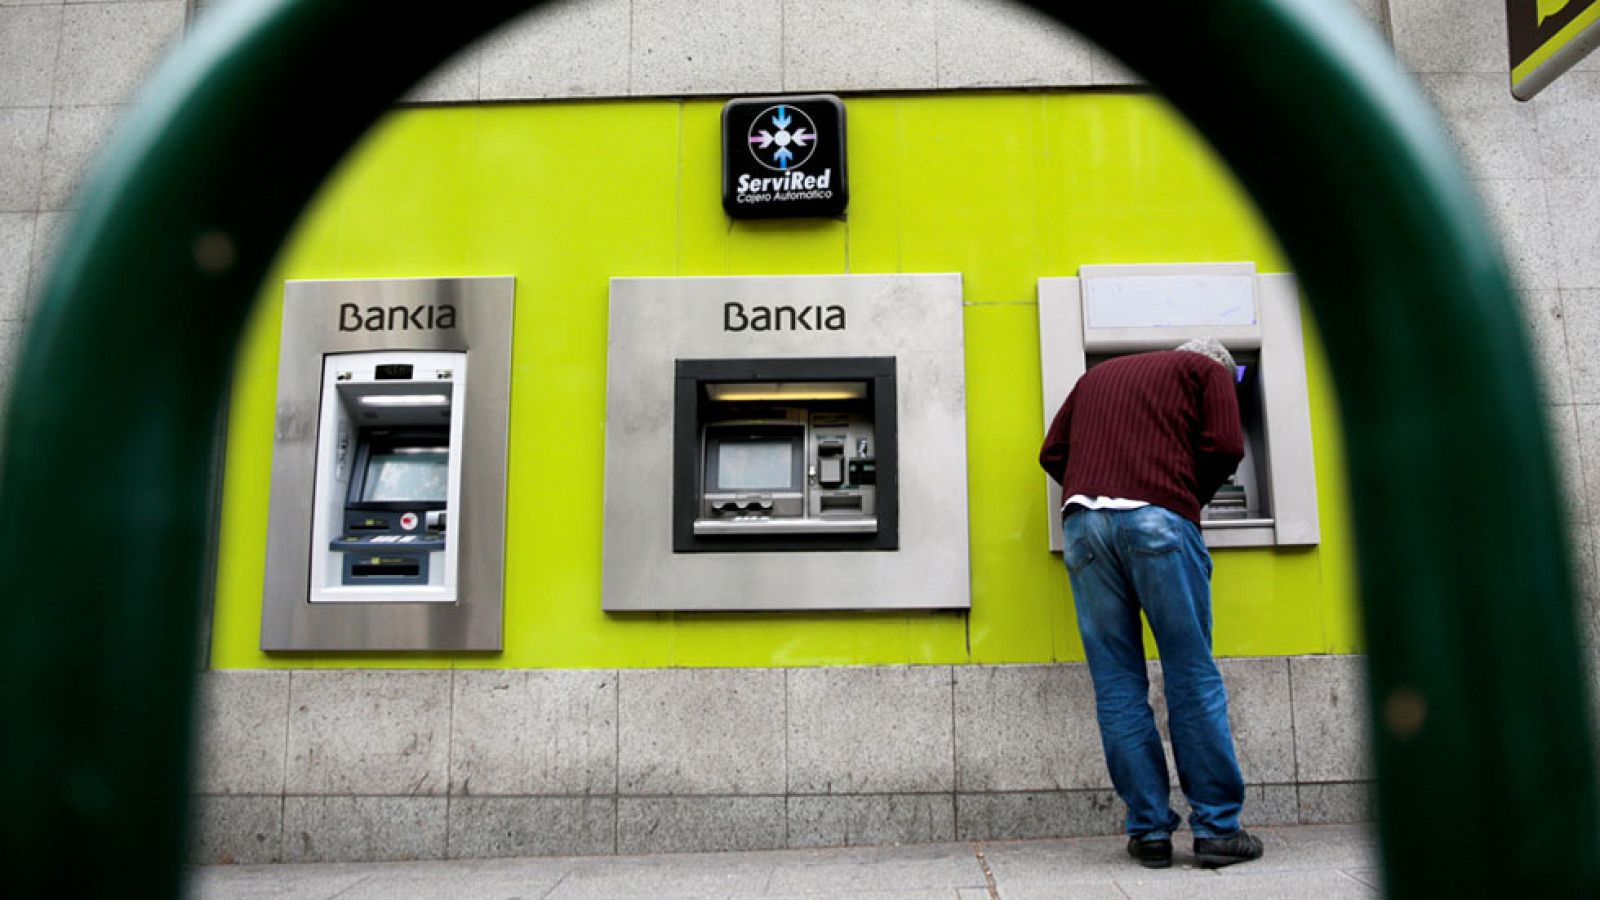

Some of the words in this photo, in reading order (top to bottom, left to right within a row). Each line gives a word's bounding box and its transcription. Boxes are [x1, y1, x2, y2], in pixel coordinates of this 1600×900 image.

[737, 168, 831, 192] ServiRed
[736, 192, 771, 204] Cajero
[338, 302, 457, 332] Bankia
[724, 301, 846, 331] Bankia
